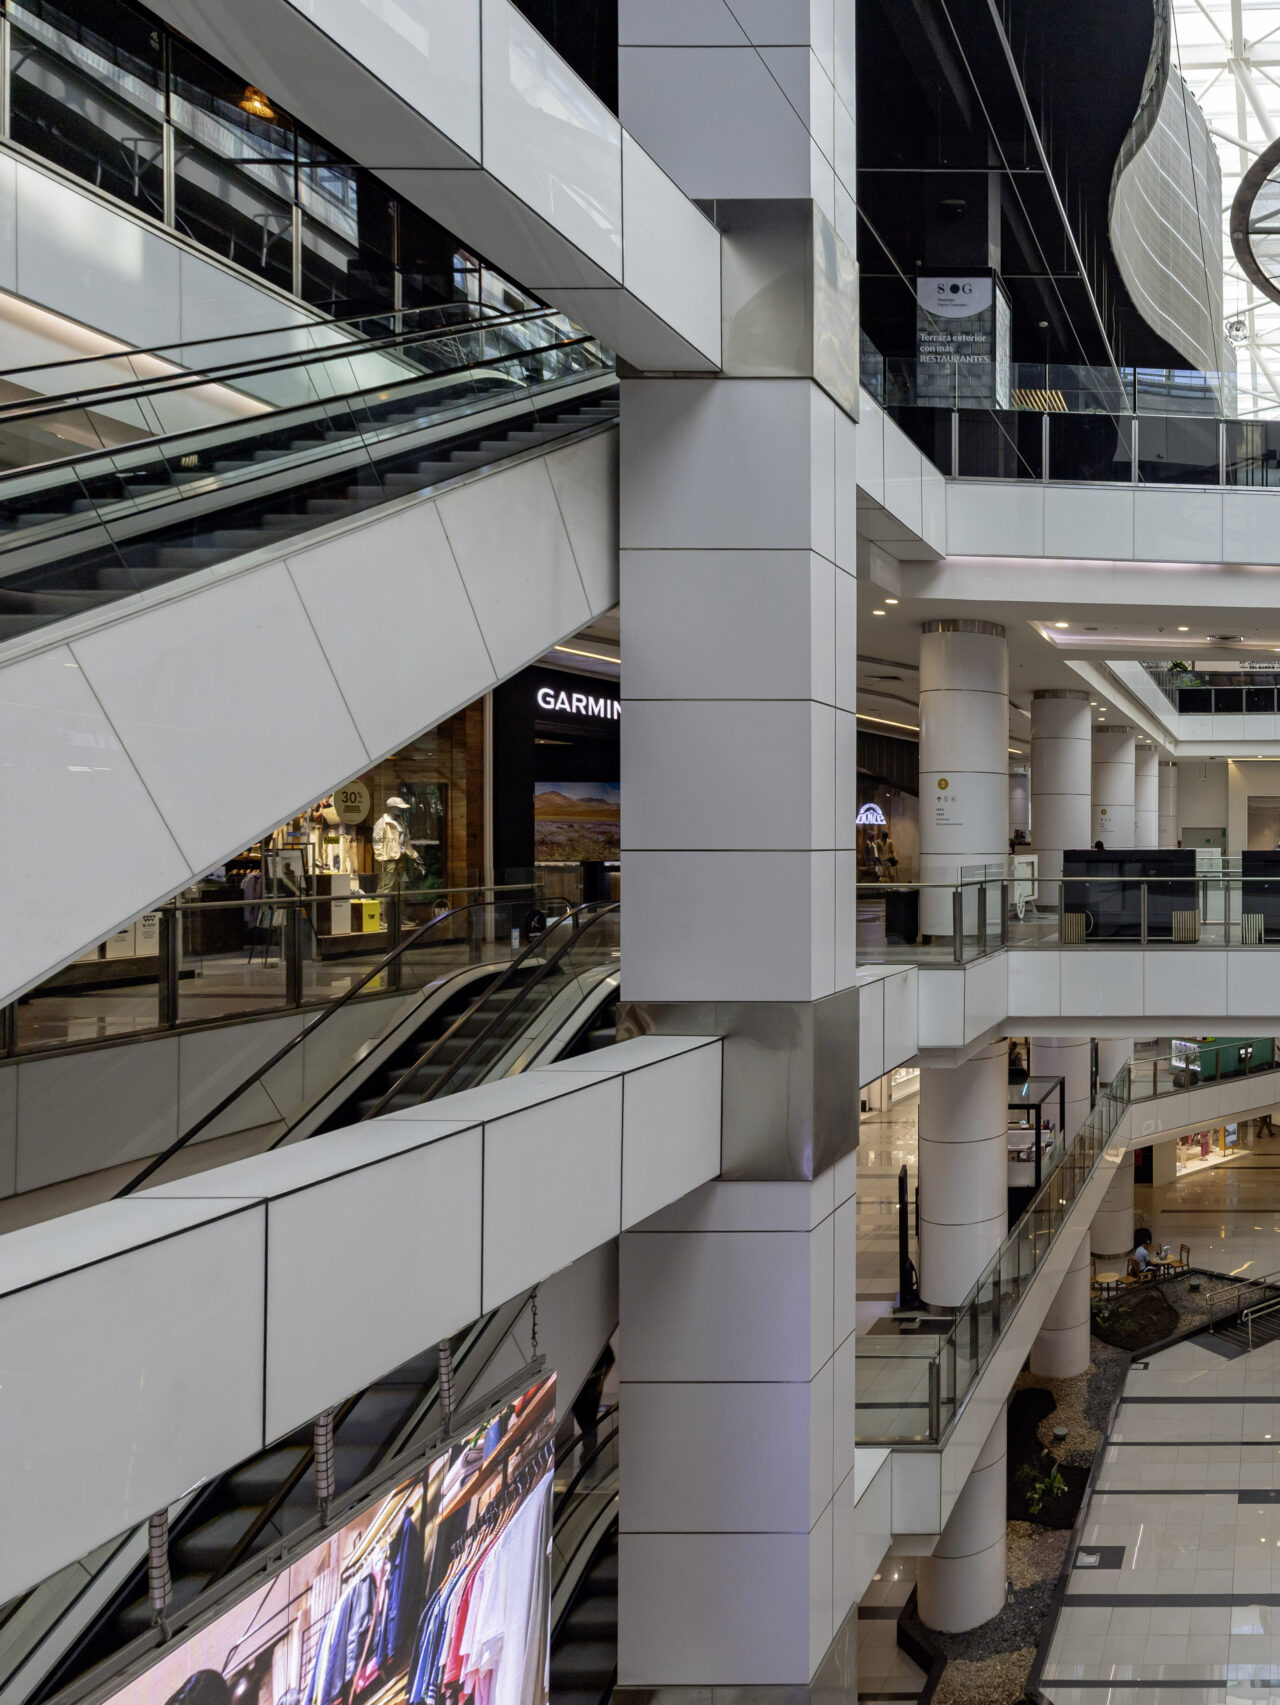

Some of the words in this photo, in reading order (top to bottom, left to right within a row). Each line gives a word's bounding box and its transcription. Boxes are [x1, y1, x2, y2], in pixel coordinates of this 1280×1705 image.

[920, 333, 951, 342] Terraza
[952, 334, 987, 342] exterior
[920, 355, 989, 363] RESTAURANTES
[537, 687, 621, 720] GARMIN
